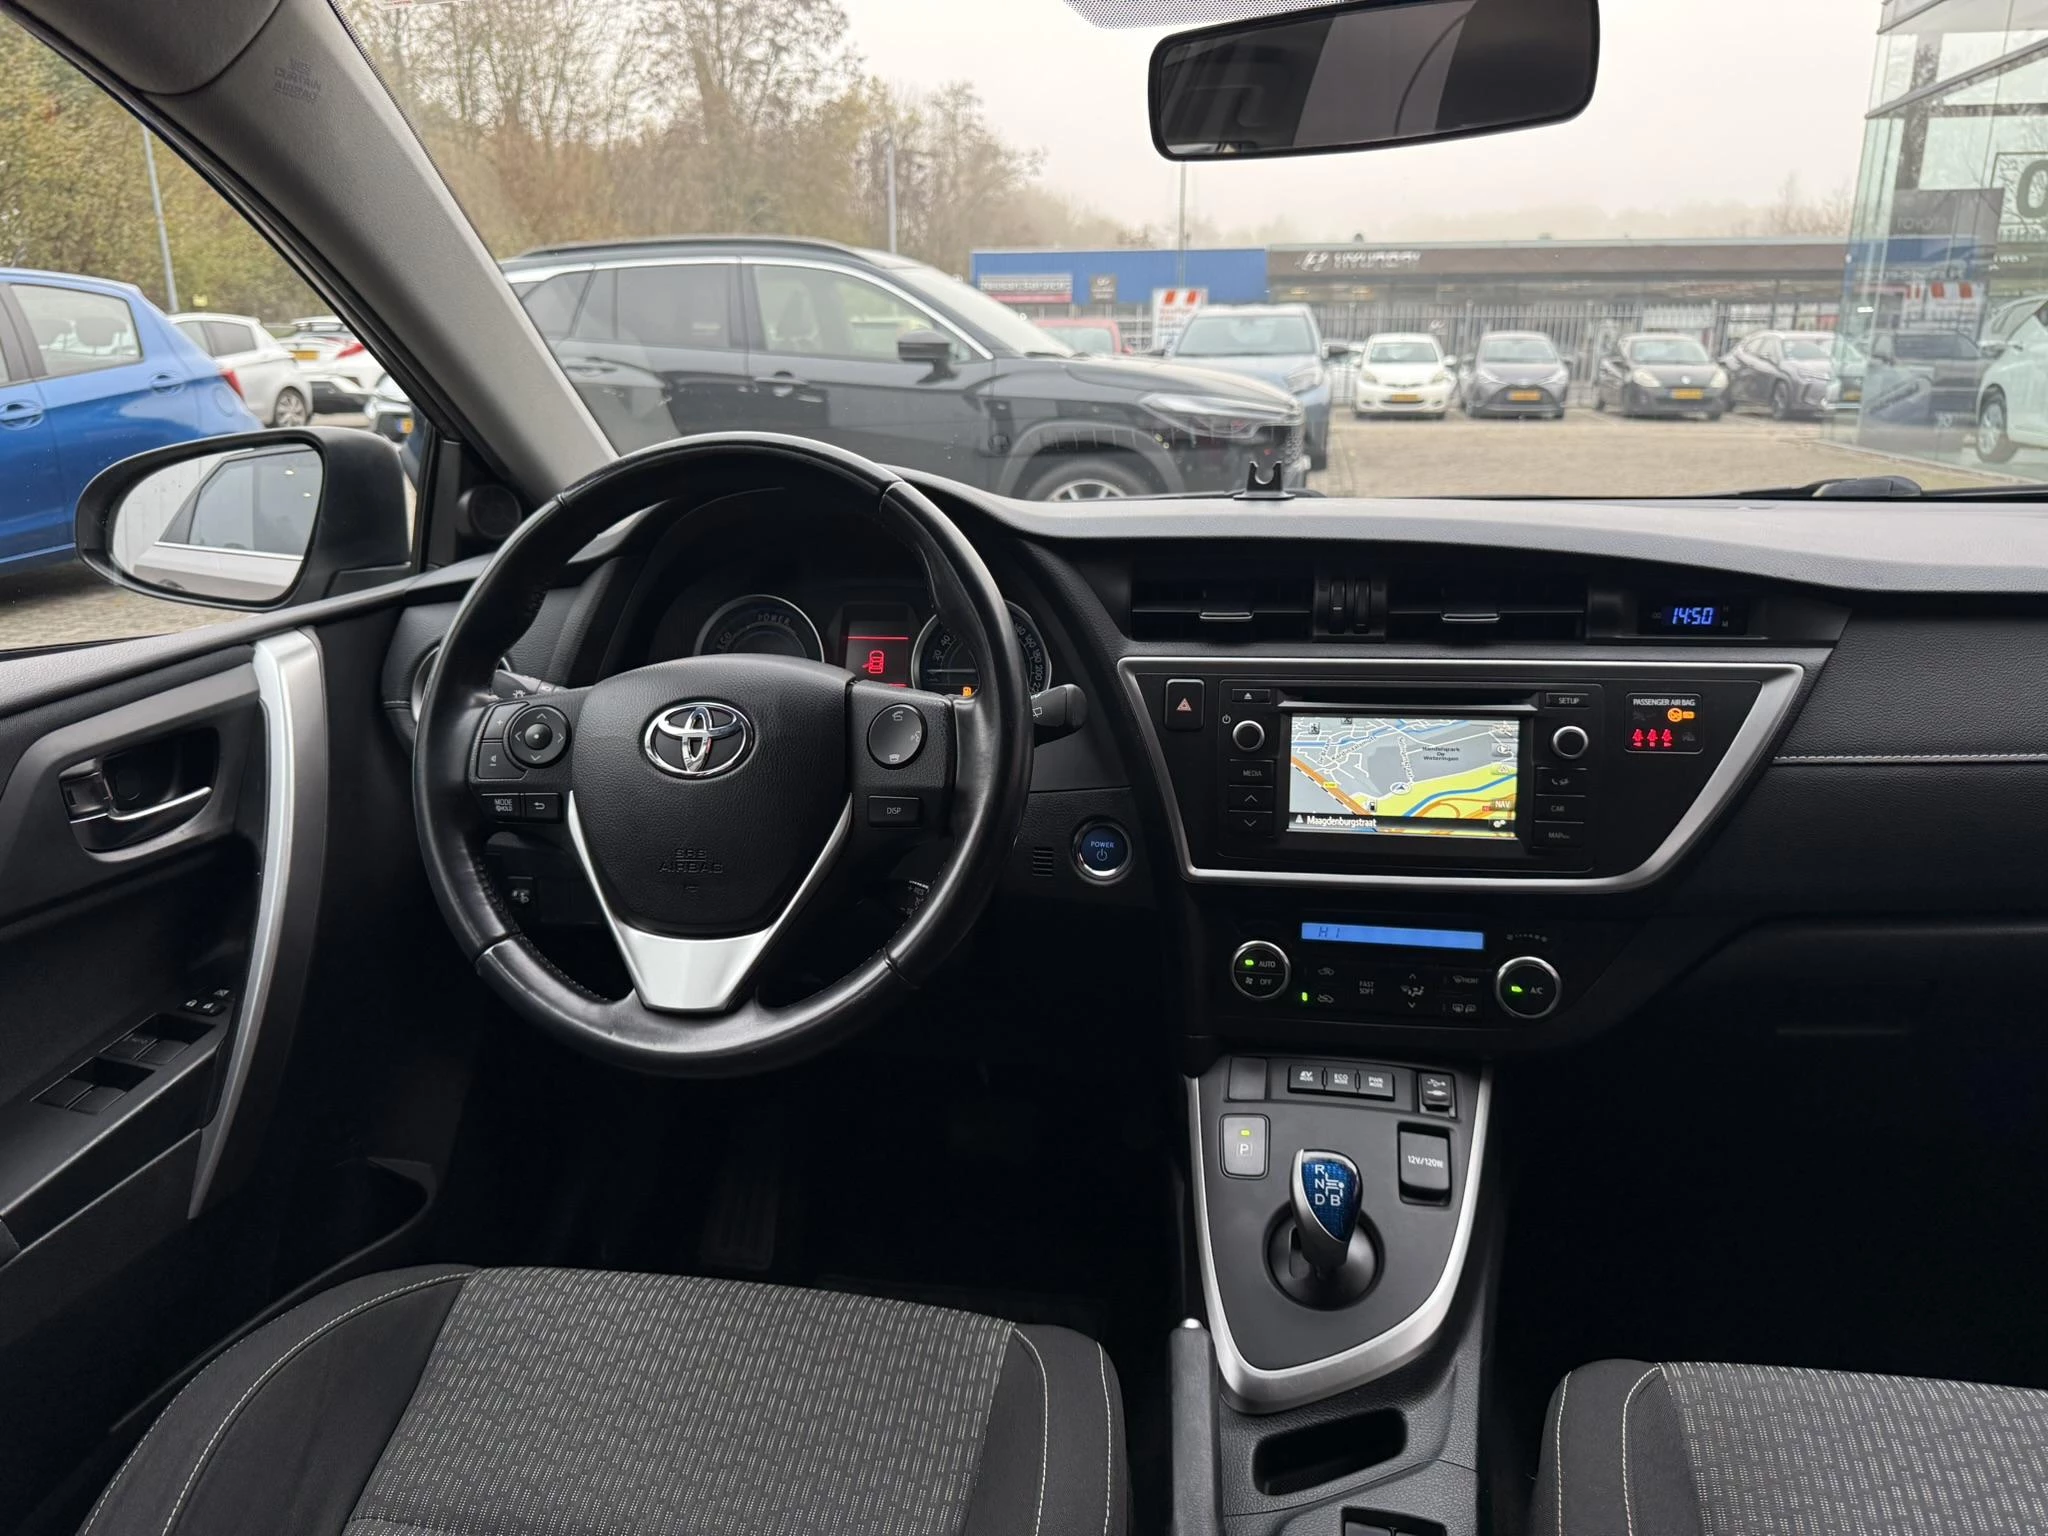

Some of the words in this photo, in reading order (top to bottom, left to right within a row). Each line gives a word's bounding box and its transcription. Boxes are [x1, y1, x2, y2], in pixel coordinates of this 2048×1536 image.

[1672, 607, 1714, 625] 14:50
[1558, 697, 1580, 705] SETUP
[1632, 698, 1670, 706] PASSENGER
[1242, 769, 1263, 777] MEDIA
[494, 798, 513, 806] MODE
[1495, 800, 1511, 808] NAV
[886, 807, 902, 815] DISP
[1306, 815, 1377, 828] Maagdenburgstraat
[1090, 840, 1115, 848] POWER
[659, 862, 724, 874] AIRBAG
[1257, 960, 1277, 969] AUTO
[1529, 985, 1545, 996] A/C
[1334, 1072, 1349, 1080] ECO
[1239, 1143, 1250, 1155] P
[1407, 1154, 1444, 1168] 12V/120W
[1314, 1164, 1325, 1175] R
[1314, 1178, 1325, 1190] N
[1314, 1193, 1326, 1206] D
[1330, 1194, 1341, 1207] B
